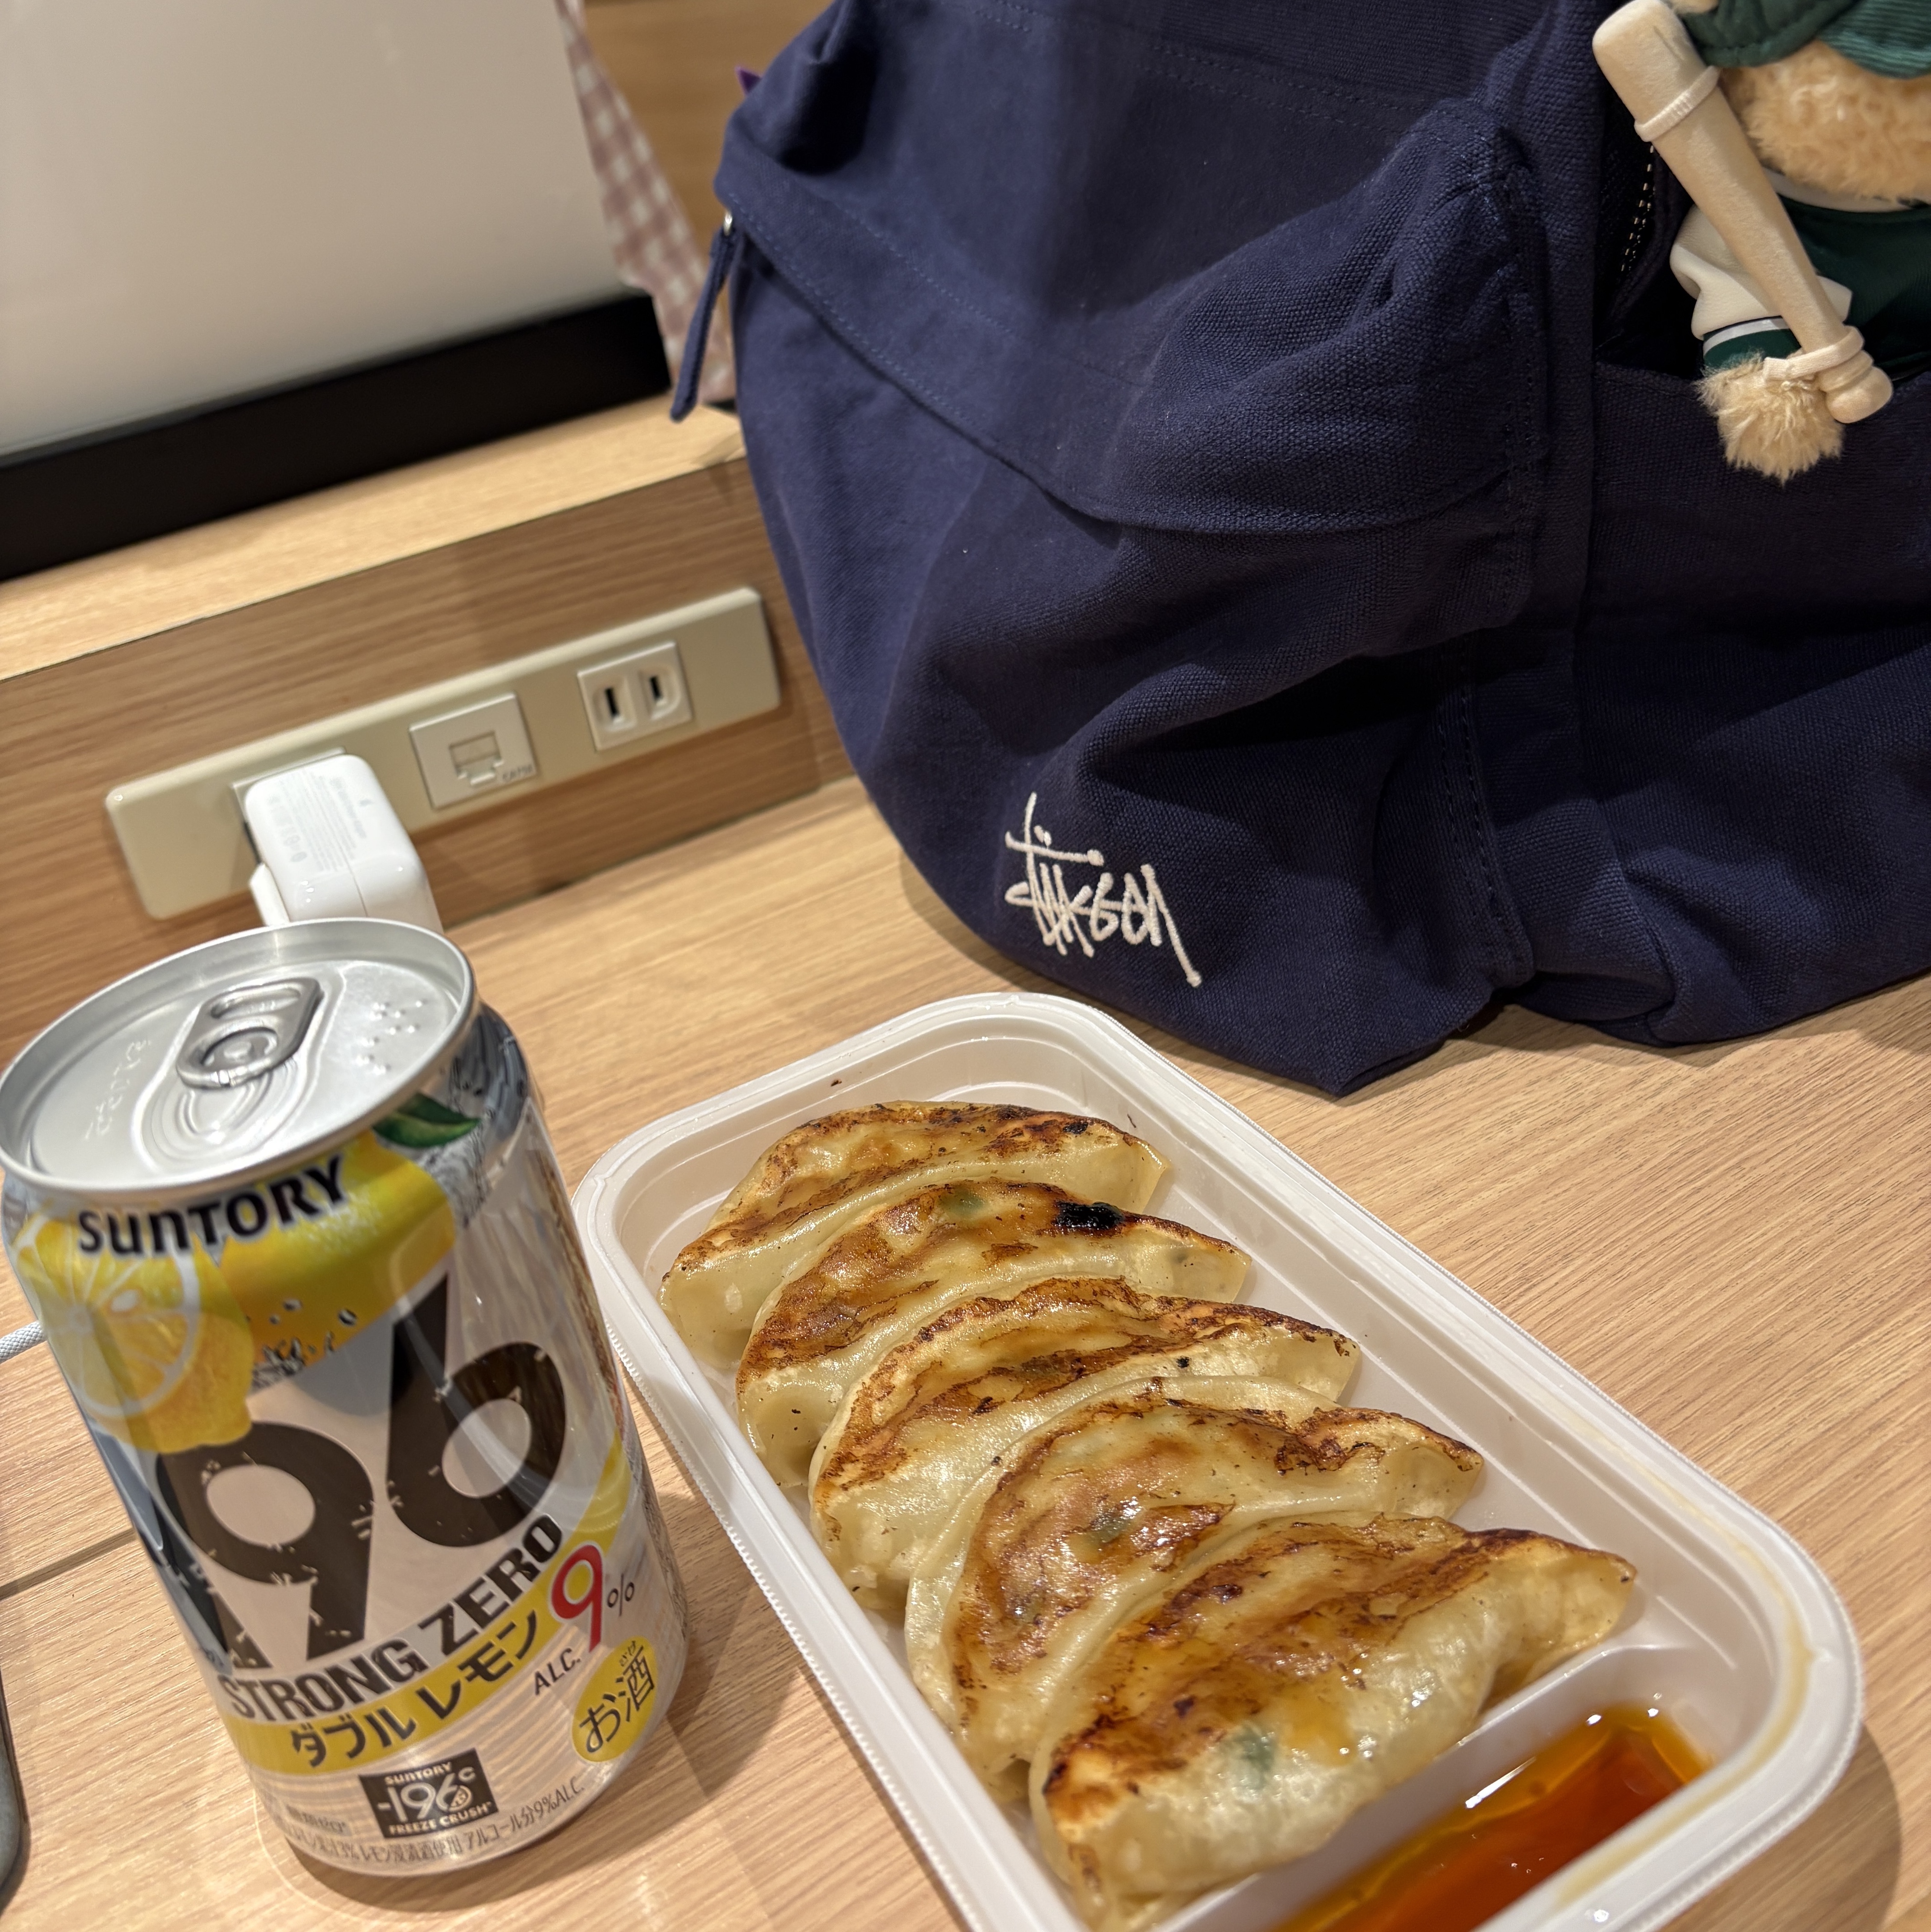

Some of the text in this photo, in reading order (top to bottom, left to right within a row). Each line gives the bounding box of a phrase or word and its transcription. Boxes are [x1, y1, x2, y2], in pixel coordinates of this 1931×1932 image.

[217, 1512, 564, 1722] STRONG ZERO
[289, 1609, 538, 1768] ダブル レモン
[534, 1647, 582, 1696] ALC.
[579, 1645, 654, 1753] お酒
[384, 1762, 452, 1785] SUNTORY
[388, 1818, 436, 1835] FREEZE
